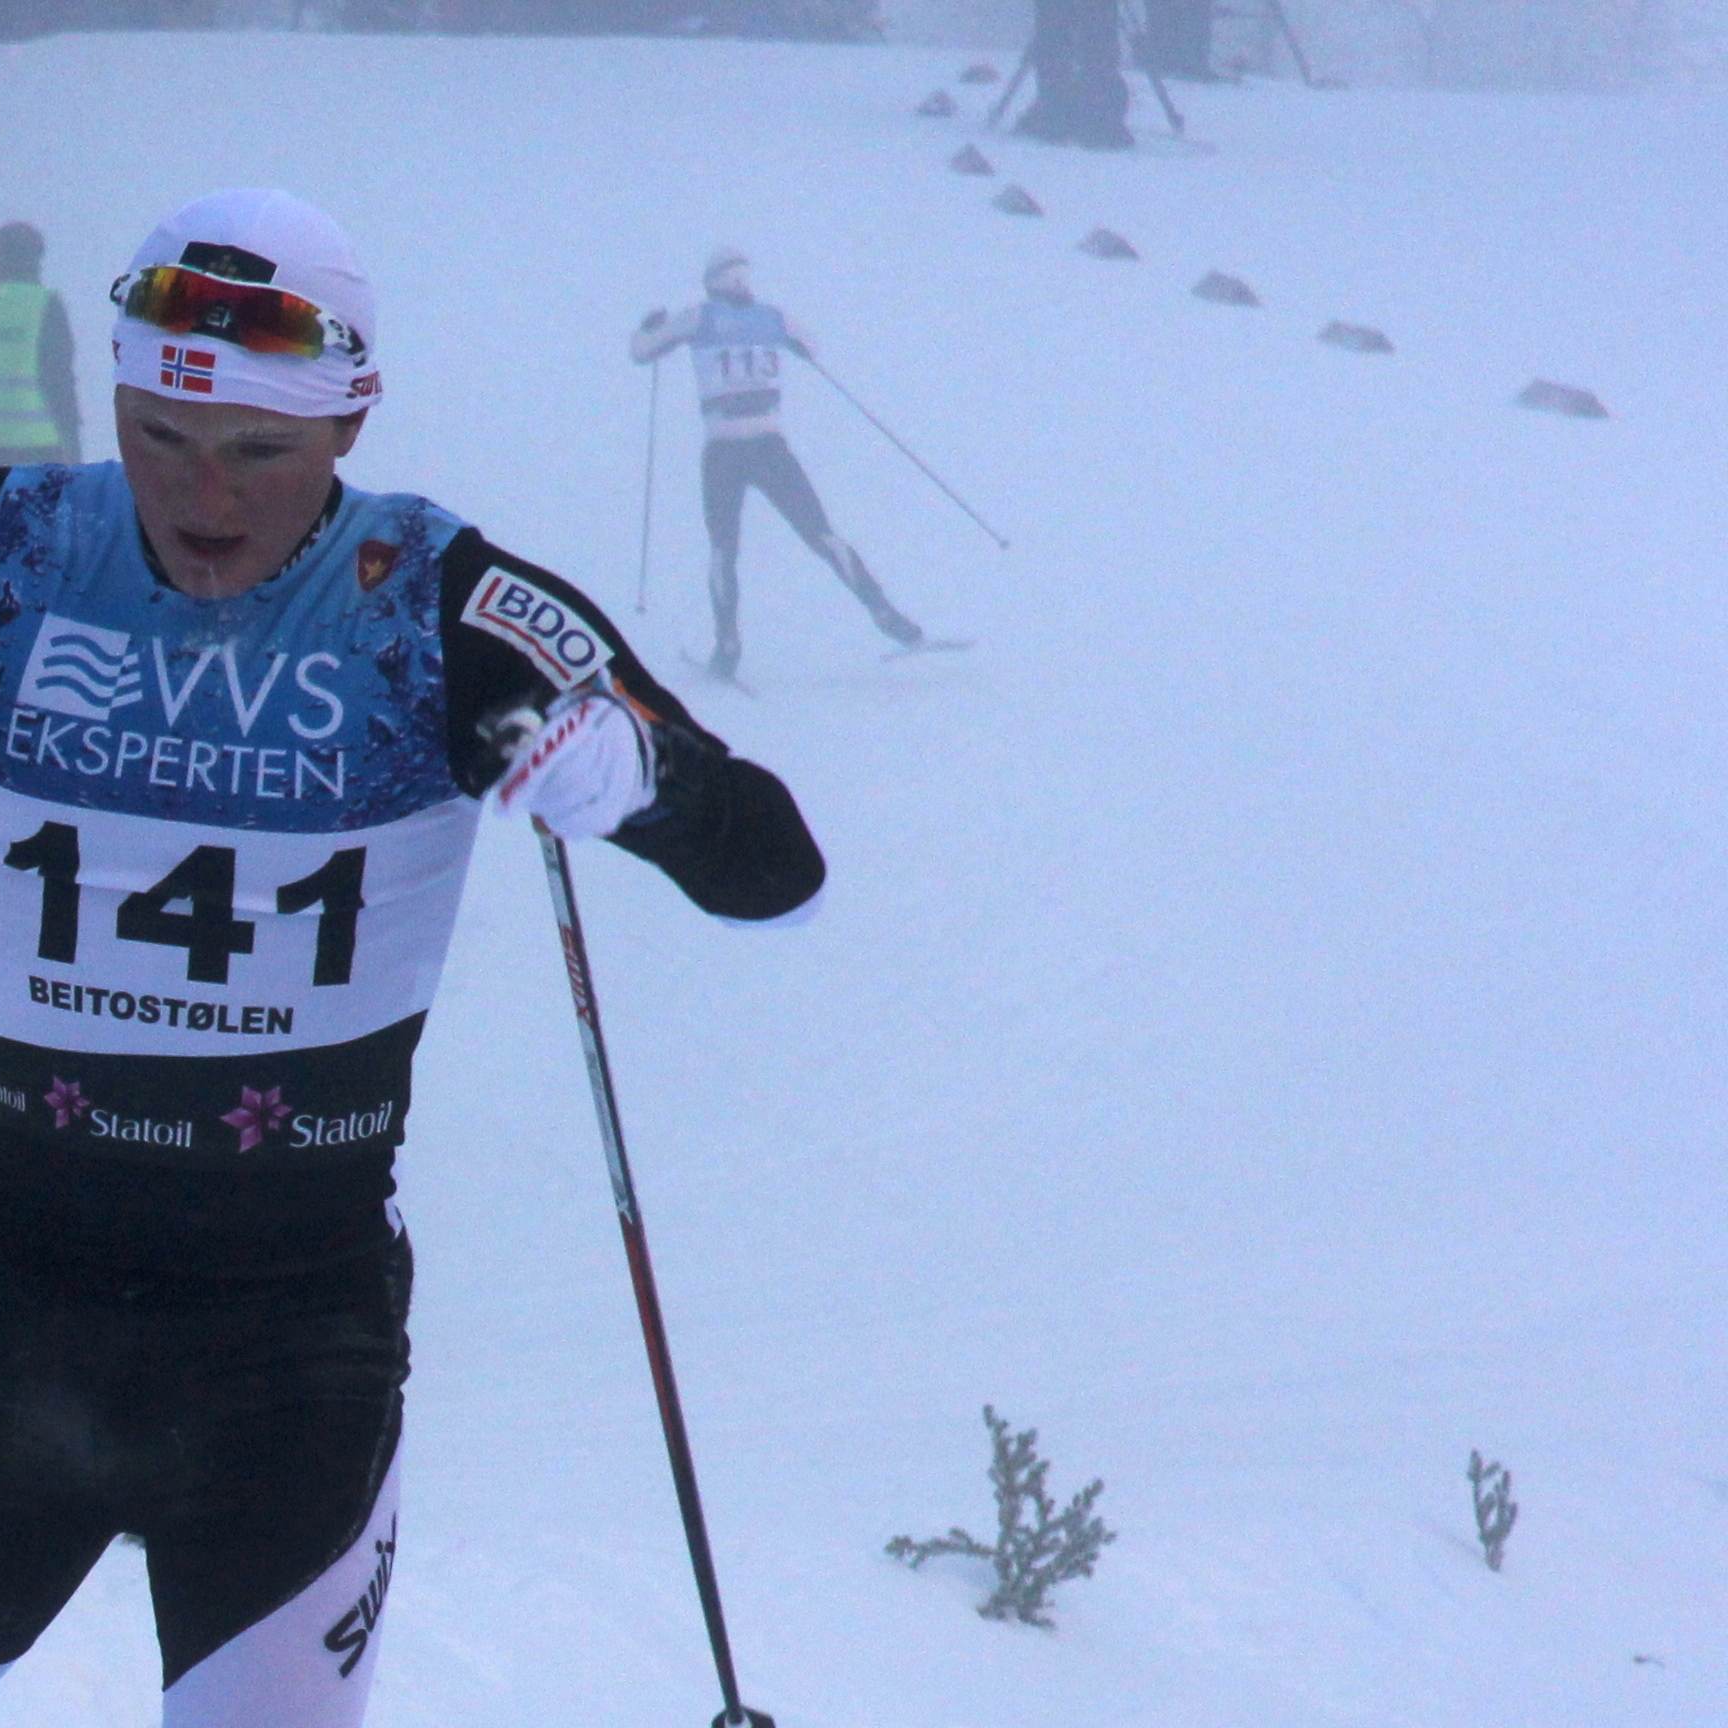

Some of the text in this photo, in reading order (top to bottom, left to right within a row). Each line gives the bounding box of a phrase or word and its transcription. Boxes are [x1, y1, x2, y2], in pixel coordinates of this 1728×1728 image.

[713, 350, 780, 379] 113
[497, 582, 596, 668] BDO
[152, 635, 344, 740] VVS
[5, 707, 344, 800] EKSPERTEN
[3, 820, 368, 987] 141
[28, 975, 294, 1035] BEITOSTØLEN
[90, 1108, 193, 1148] Statoil
[289, 1100, 393, 1149] Statoil
